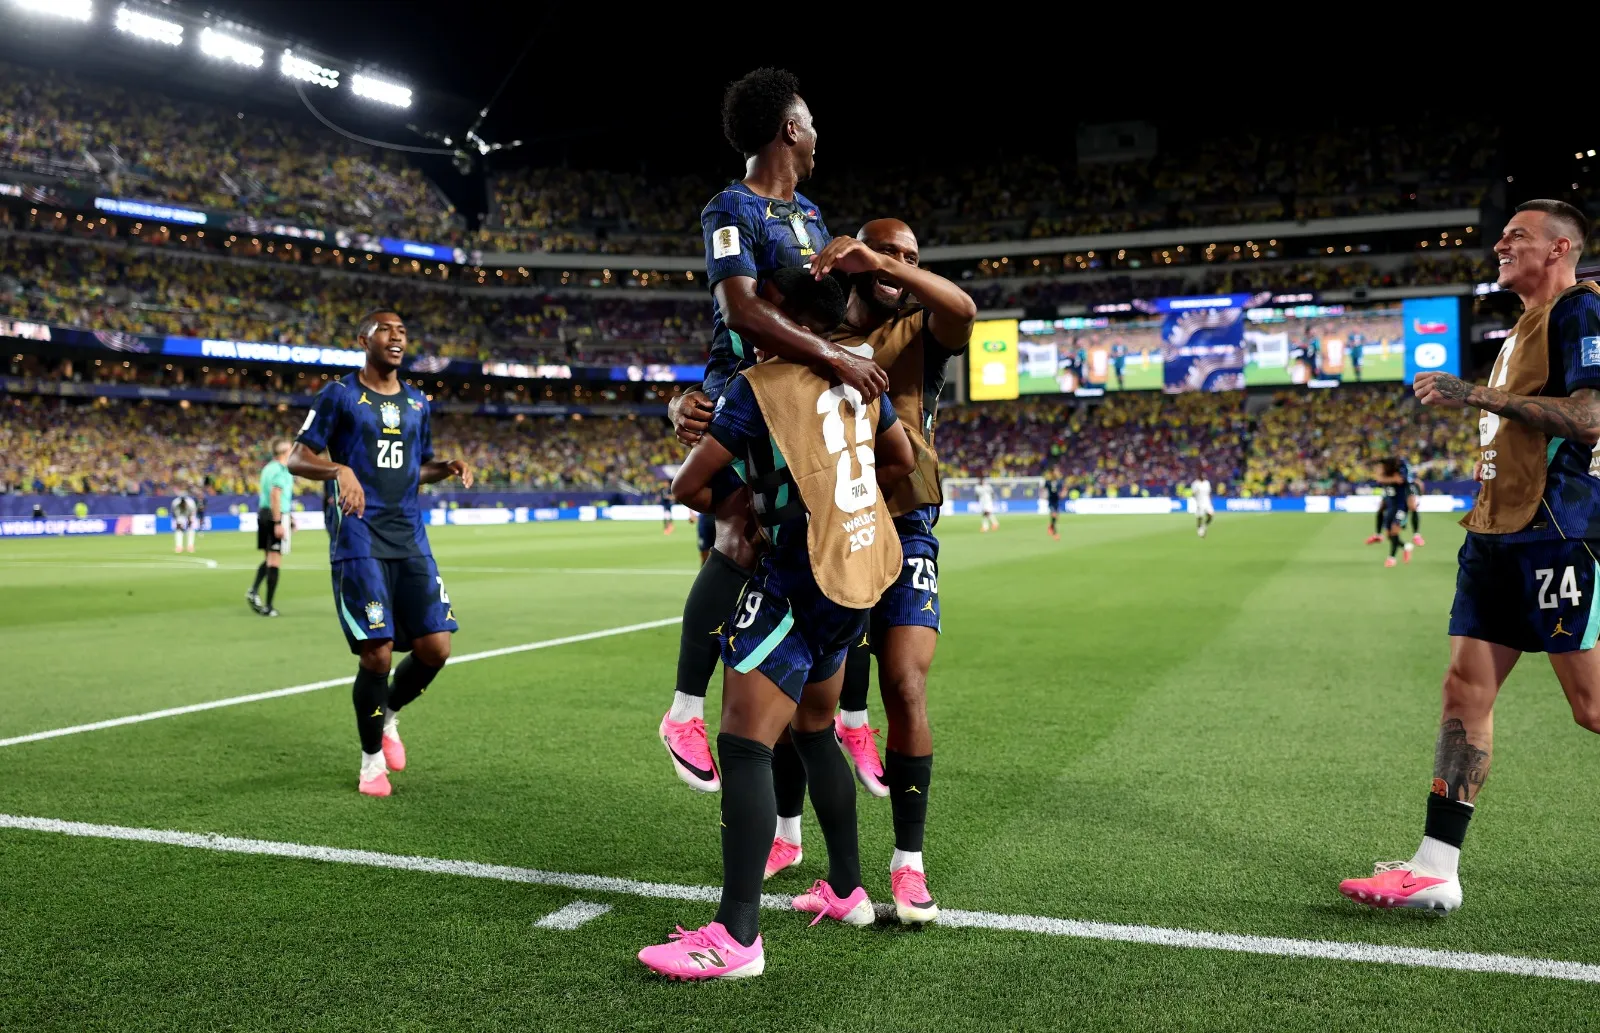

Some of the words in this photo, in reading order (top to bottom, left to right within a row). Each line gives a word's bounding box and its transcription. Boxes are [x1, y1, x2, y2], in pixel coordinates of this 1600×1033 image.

[202, 339, 237, 358] FIFA
[237, 342, 291, 362] WORLD
[291, 346, 321, 364] CUP
[376, 439, 404, 469] 26
[2, 520, 45, 535] WORLD
[45, 519, 67, 534] CUP
[842, 513, 871, 533] WRLD
[435, 575, 451, 604] 2
[907, 557, 938, 594] 25
[1535, 565, 1582, 610] 24
